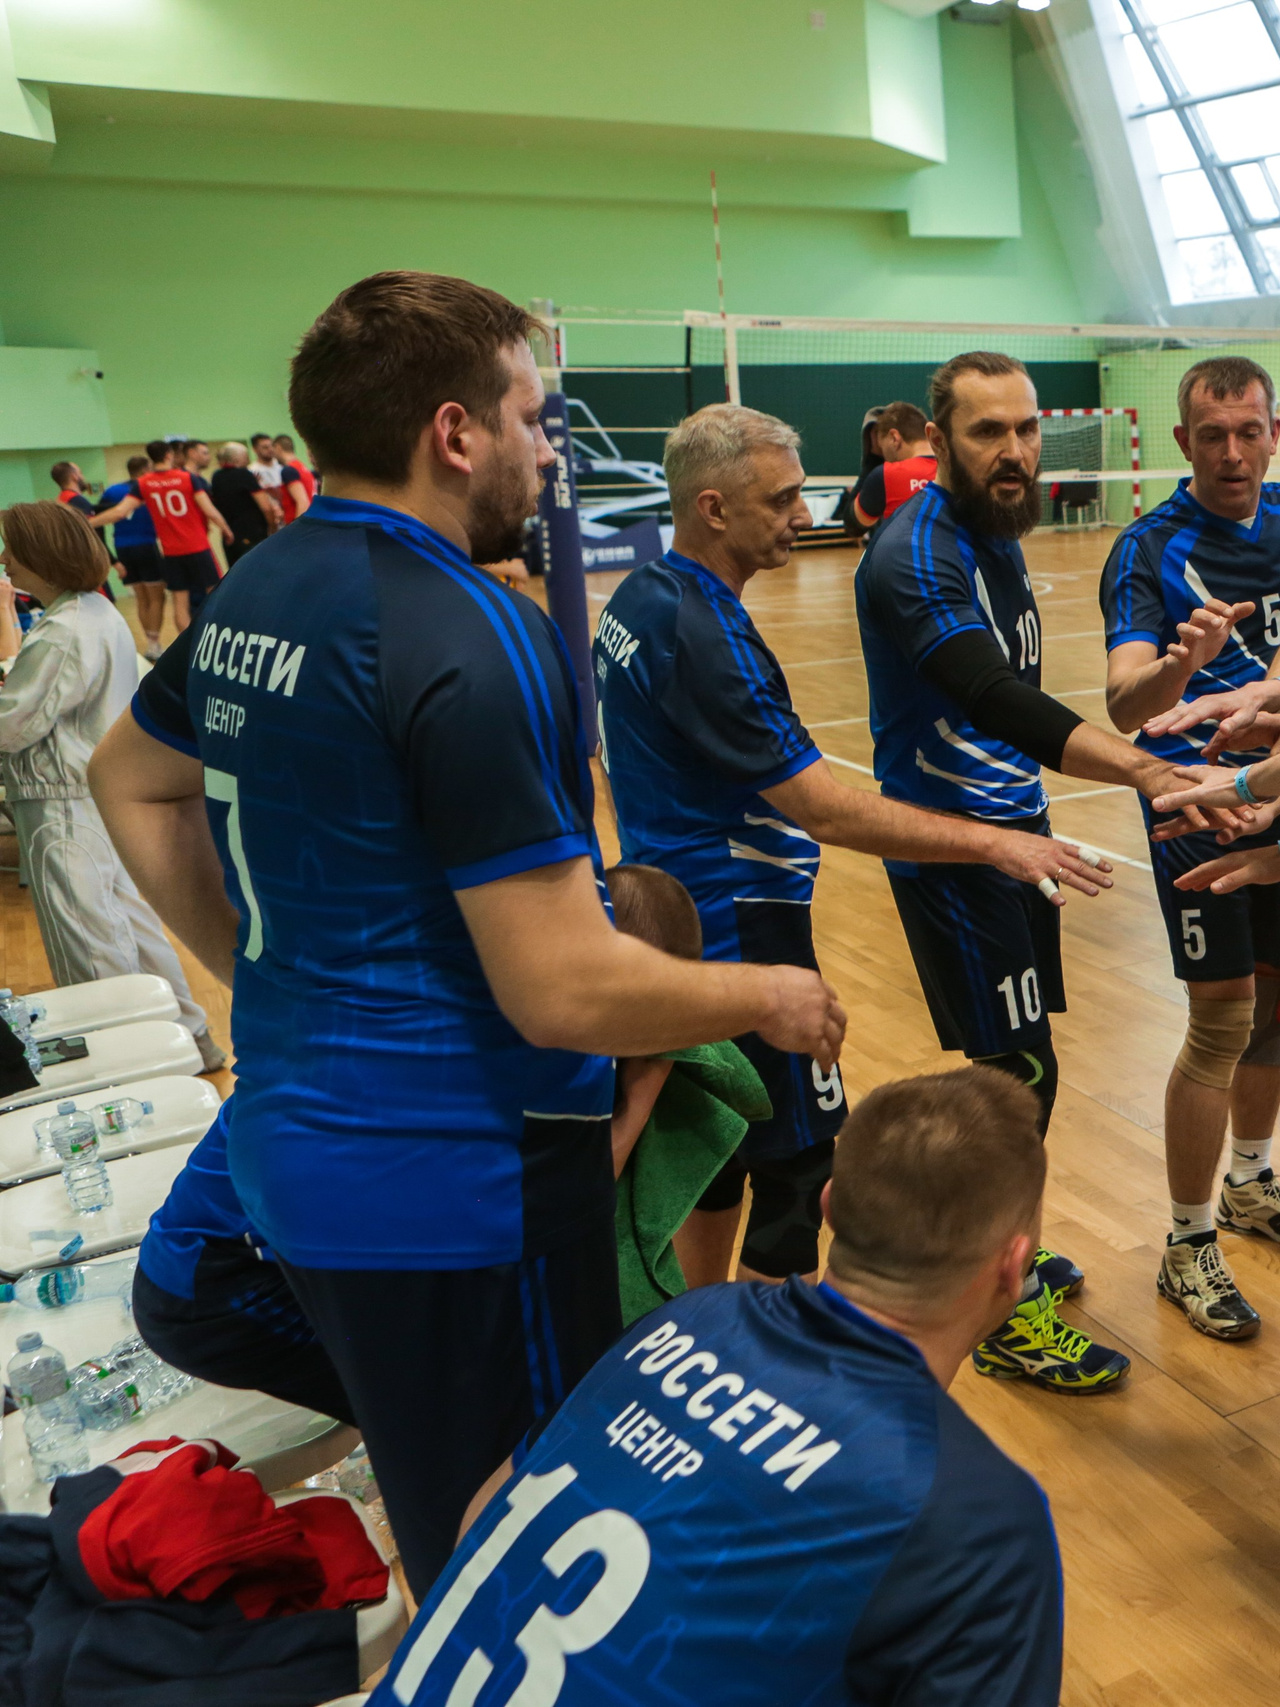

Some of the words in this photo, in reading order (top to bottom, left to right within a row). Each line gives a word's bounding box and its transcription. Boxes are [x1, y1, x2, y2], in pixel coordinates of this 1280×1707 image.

[149, 489, 188, 517] 10
[595, 610, 641, 669] ОССЕТИ
[1015, 609, 1040, 671] 10
[204, 695, 246, 739] ЦЕНТР
[203, 766, 263, 963] 7
[1182, 908, 1206, 961] 5
[997, 966, 1041, 1031] 10
[811, 1058, 844, 1112] 9
[624, 1320, 842, 1492] РОССЕТИ
[605, 1401, 704, 1482] ЦЕНТР
[394, 1462, 651, 1707] 13
